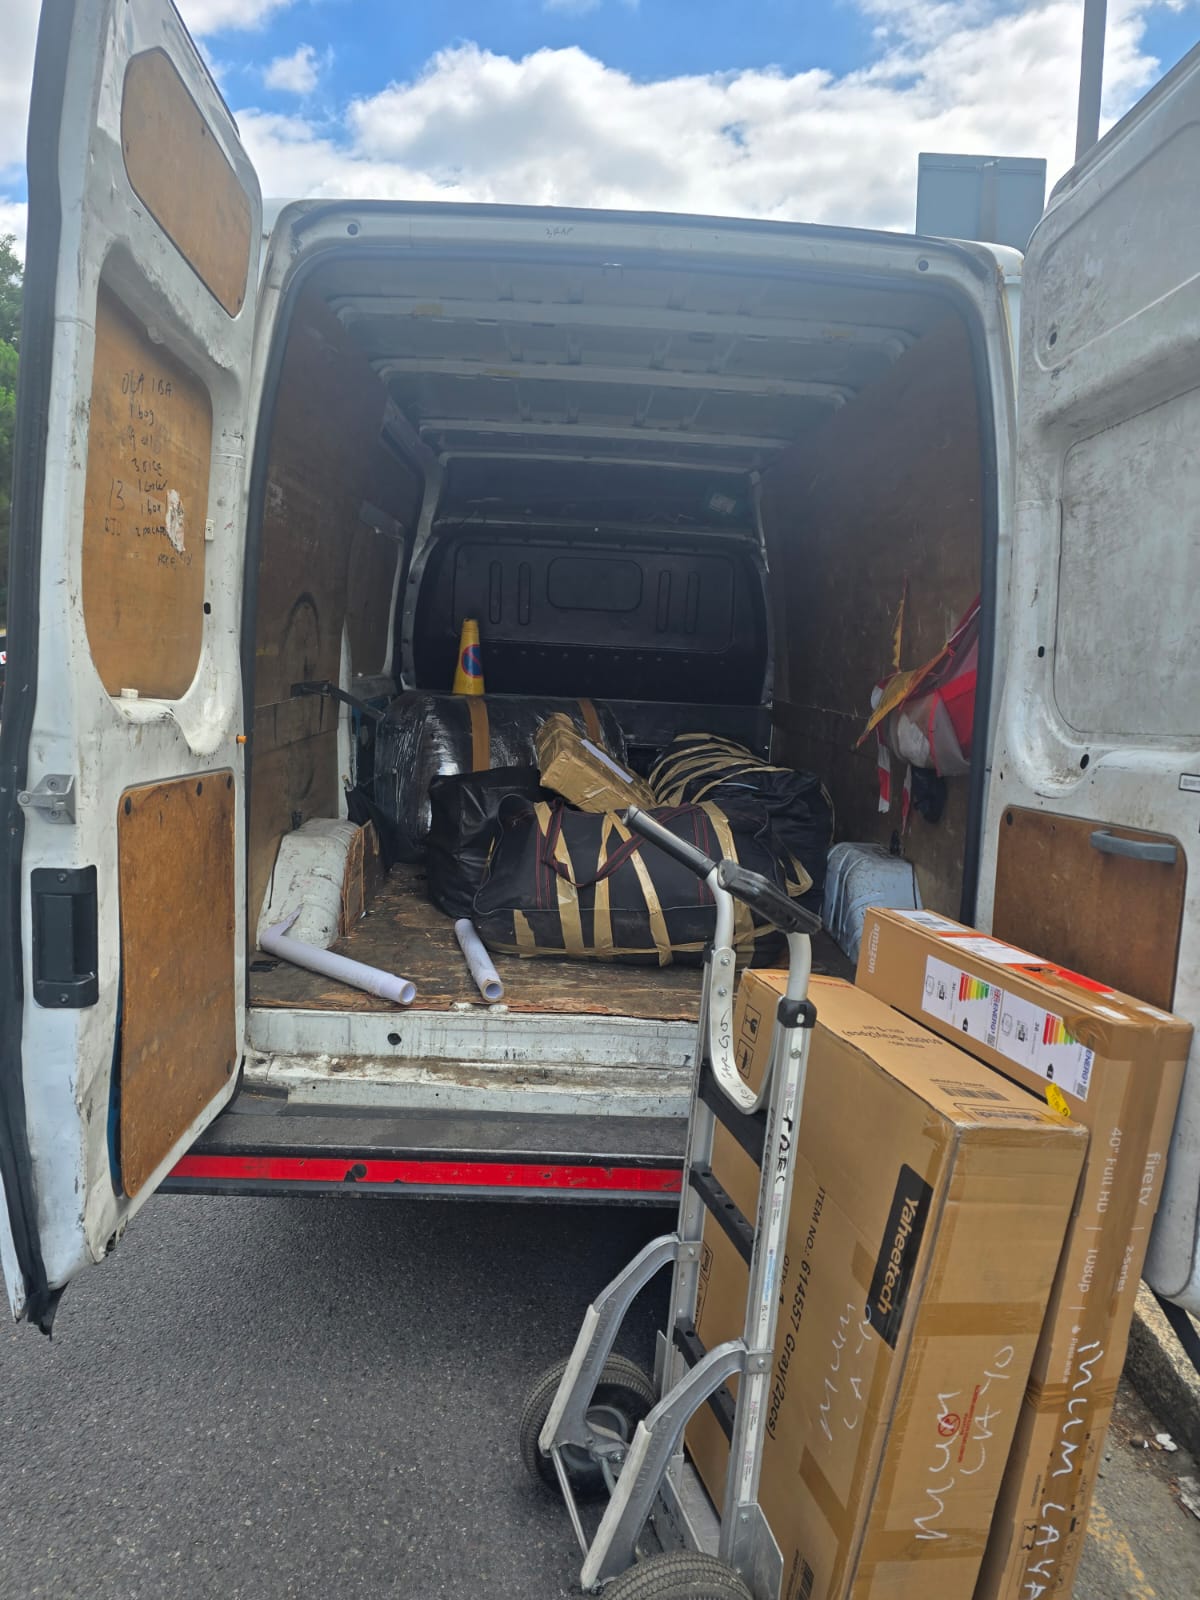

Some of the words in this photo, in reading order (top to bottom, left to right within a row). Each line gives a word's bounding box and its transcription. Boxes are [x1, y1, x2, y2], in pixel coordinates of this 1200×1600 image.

[868, 923, 880, 975] amazon
[1102, 1157, 1117, 1186] Full
[811, 1186, 826, 1221] ITEM
[1096, 1190, 1110, 1213] HD
[875, 1197, 920, 1317] Yaheetech
[1117, 1245, 1135, 1293] 2-Series
[791, 1259, 812, 1333] 614557
[766, 1334, 796, 1442] Gray(2pcs)
